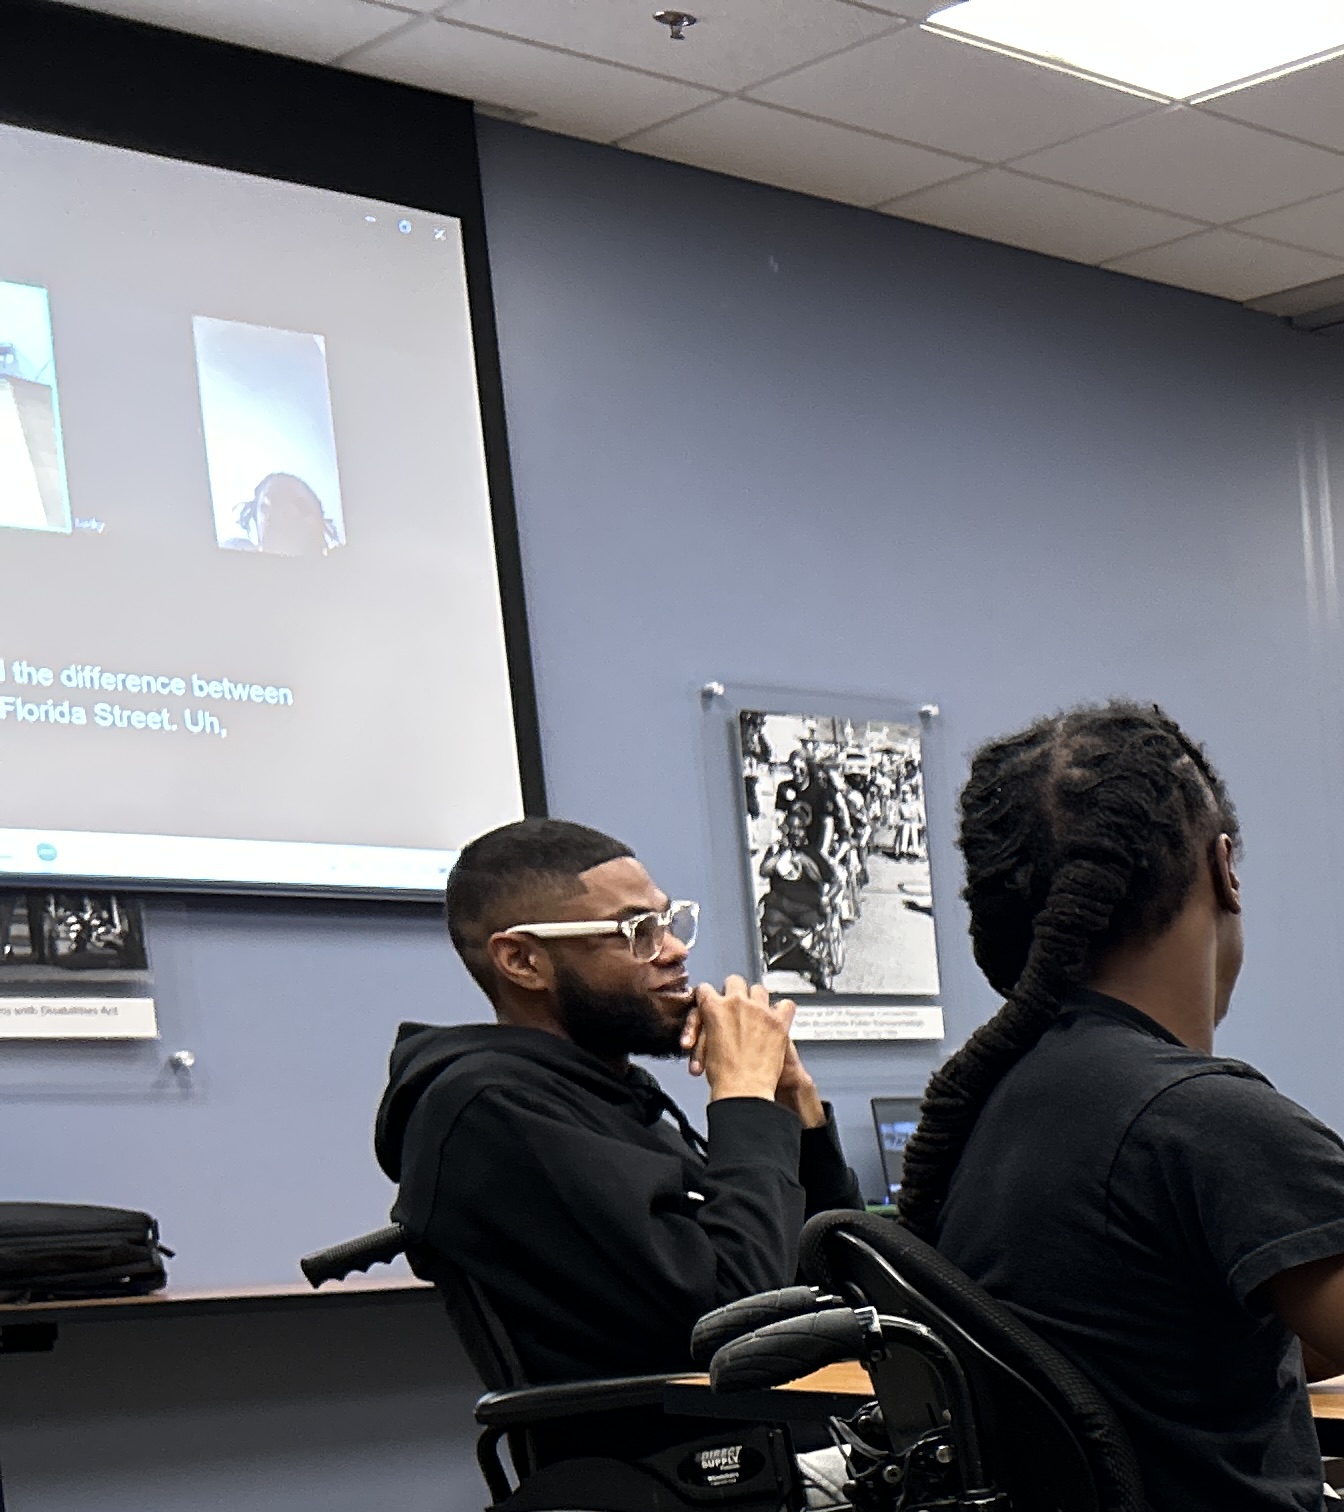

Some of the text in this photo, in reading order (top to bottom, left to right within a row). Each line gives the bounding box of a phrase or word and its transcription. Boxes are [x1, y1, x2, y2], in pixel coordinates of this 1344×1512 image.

[12, 660, 54, 687] the
[60, 664, 186, 696] difference
[191, 674, 293, 705] between
[0, 696, 227, 738] Florida Street. Uh,
